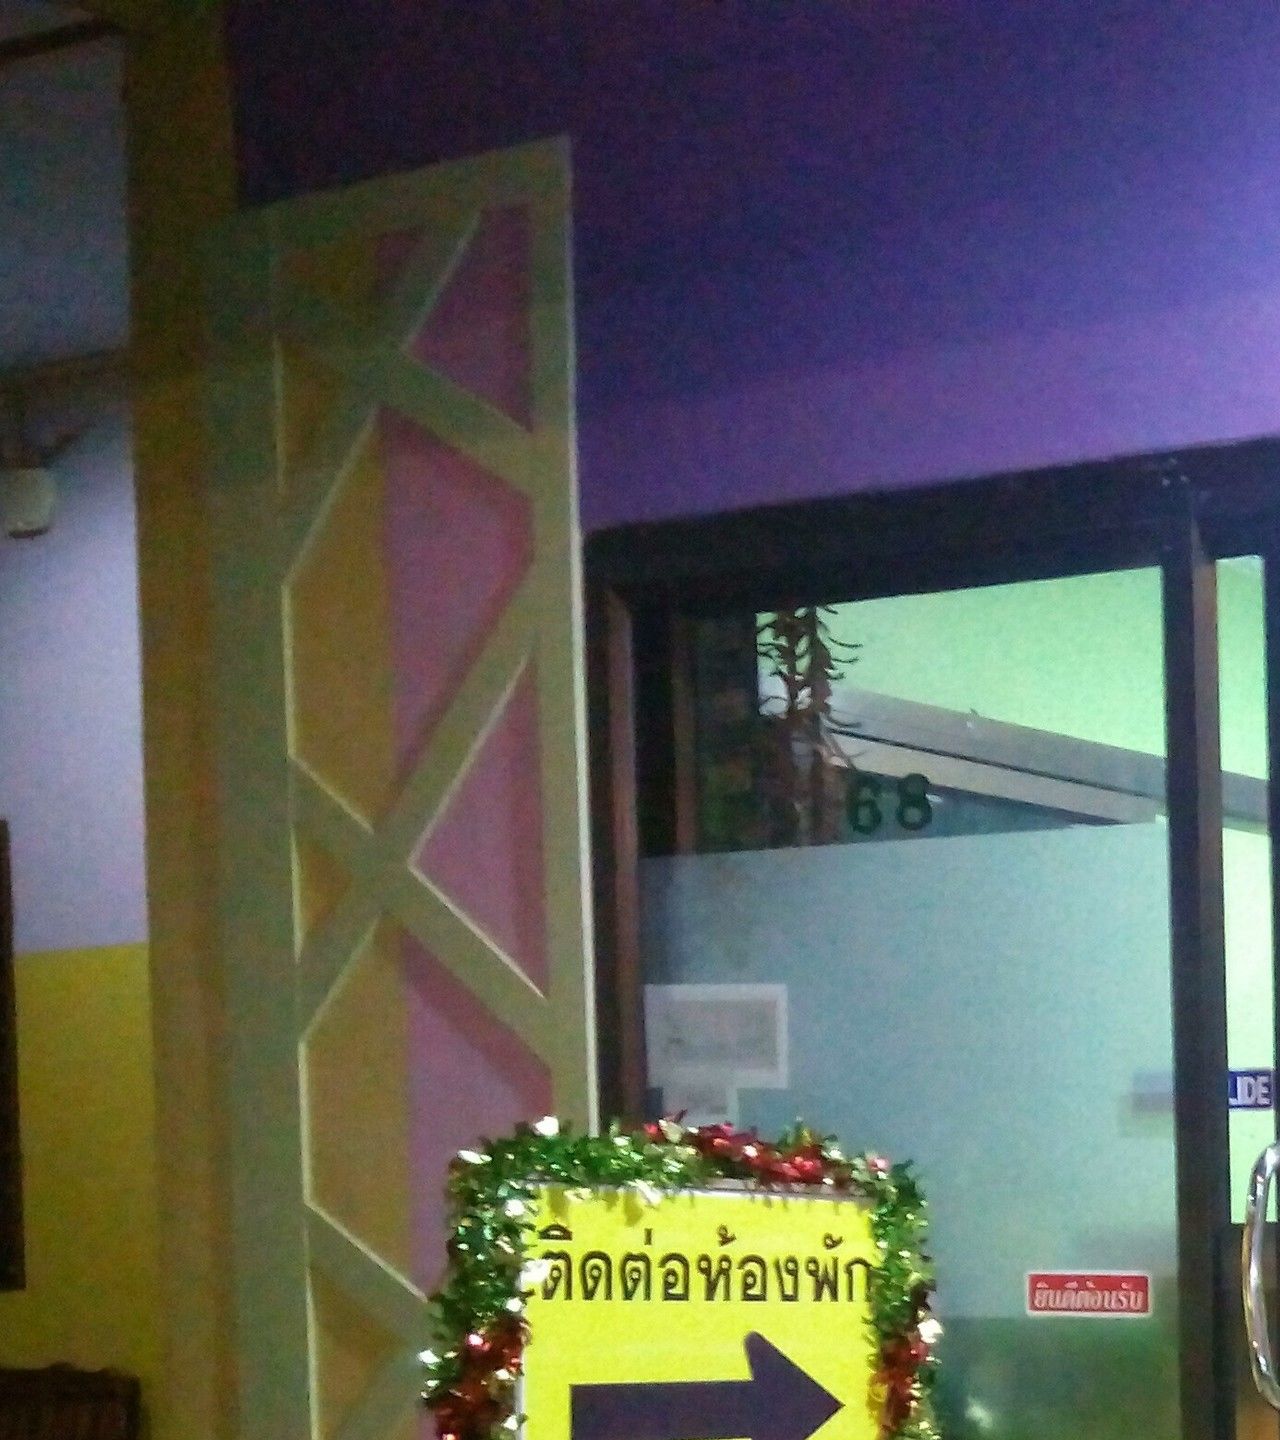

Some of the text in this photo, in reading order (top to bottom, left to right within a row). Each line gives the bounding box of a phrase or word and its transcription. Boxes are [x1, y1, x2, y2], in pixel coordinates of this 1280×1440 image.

[539, 1223, 873, 1301] ติดต่อห้องพัก
